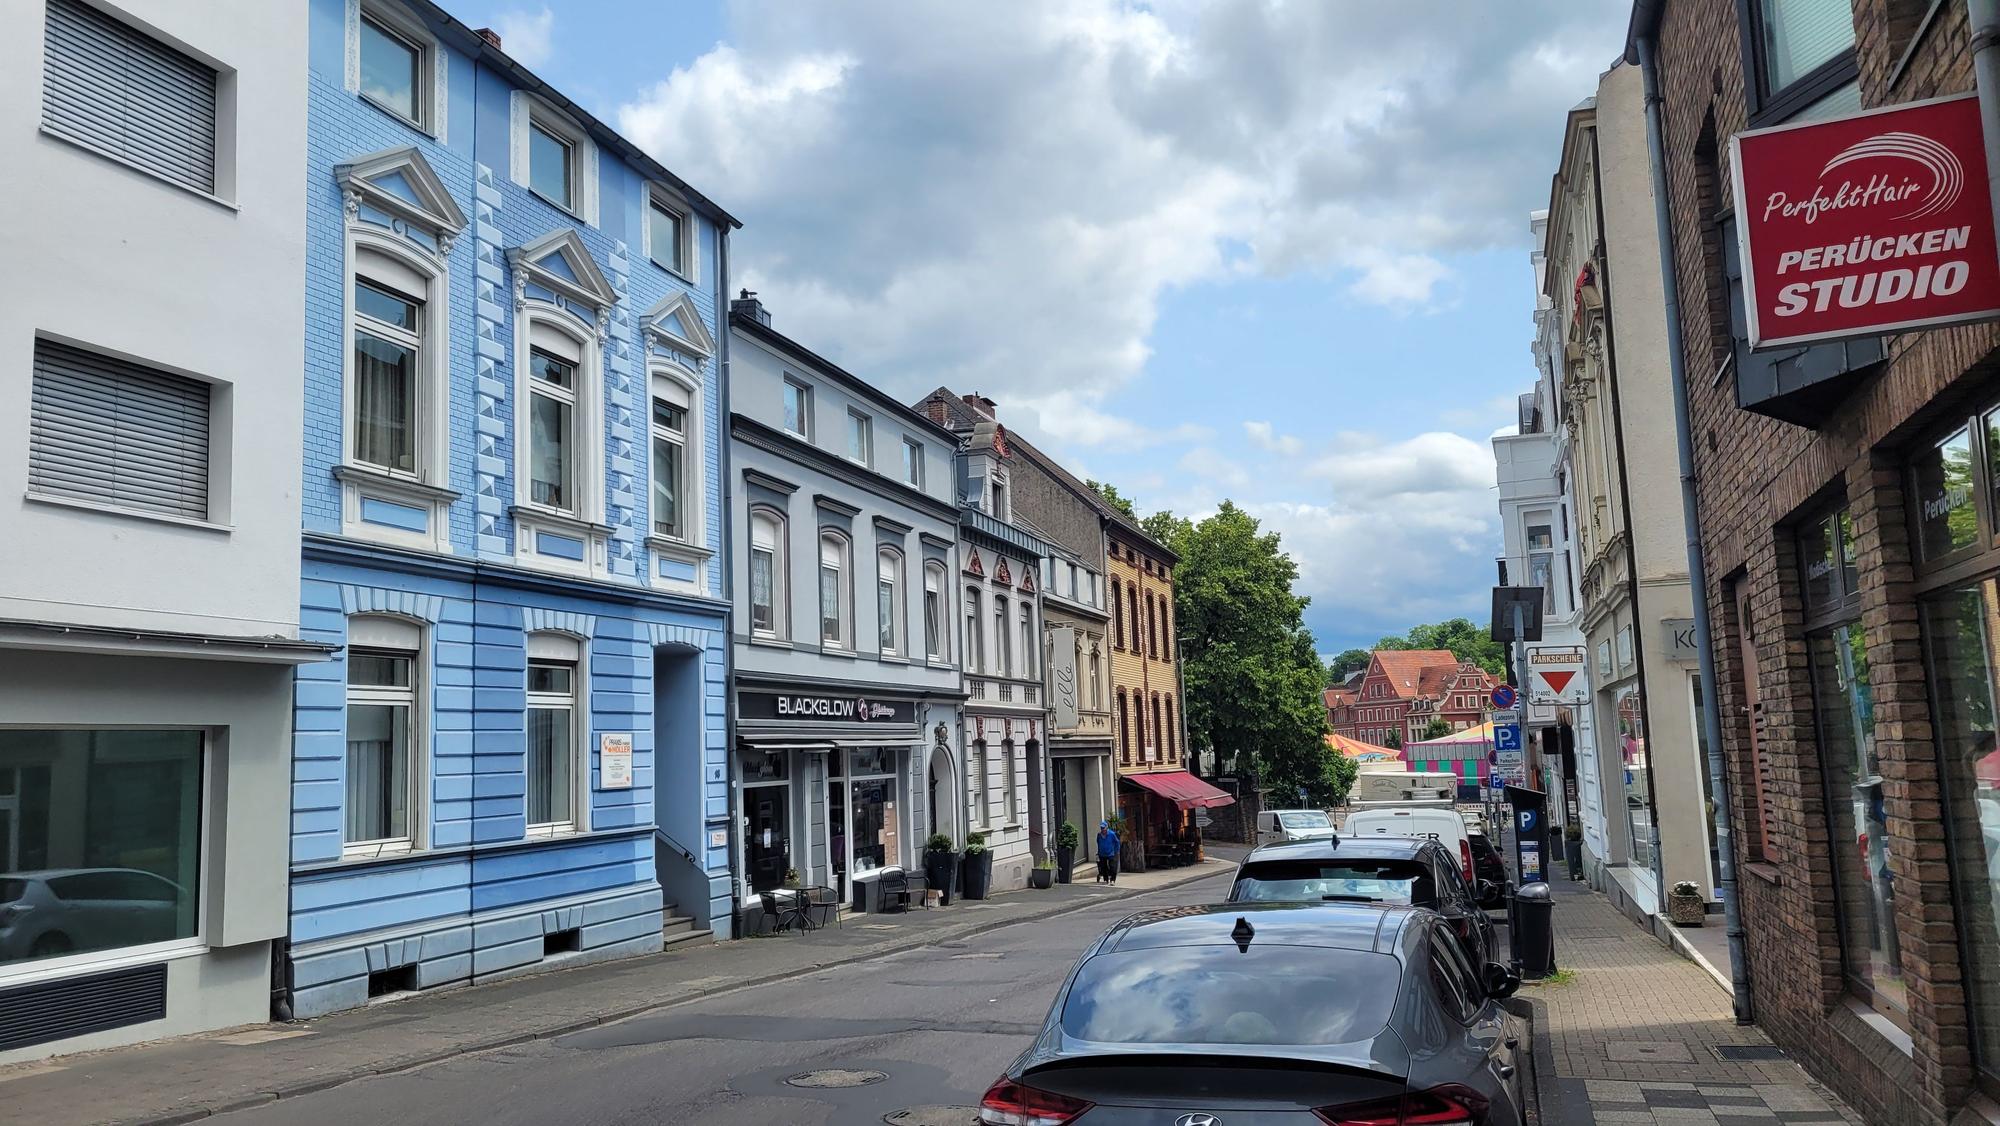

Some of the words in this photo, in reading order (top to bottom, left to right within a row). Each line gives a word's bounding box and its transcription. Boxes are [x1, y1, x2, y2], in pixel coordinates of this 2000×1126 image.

[1763, 174, 1920, 225] PerfektHair
[1776, 225, 1971, 275] PERÜCKEN
[1774, 260, 1970, 317] STUDIO
[1924, 486, 1968, 523] Perücken
[1533, 654, 1581, 663] PARKSCHEINE
[778, 697, 854, 716] BLACKGLOW
[1495, 713, 1516, 721] Ladezone
[1497, 728, 1512, 748] P
[1520, 811, 1532, 828] P
